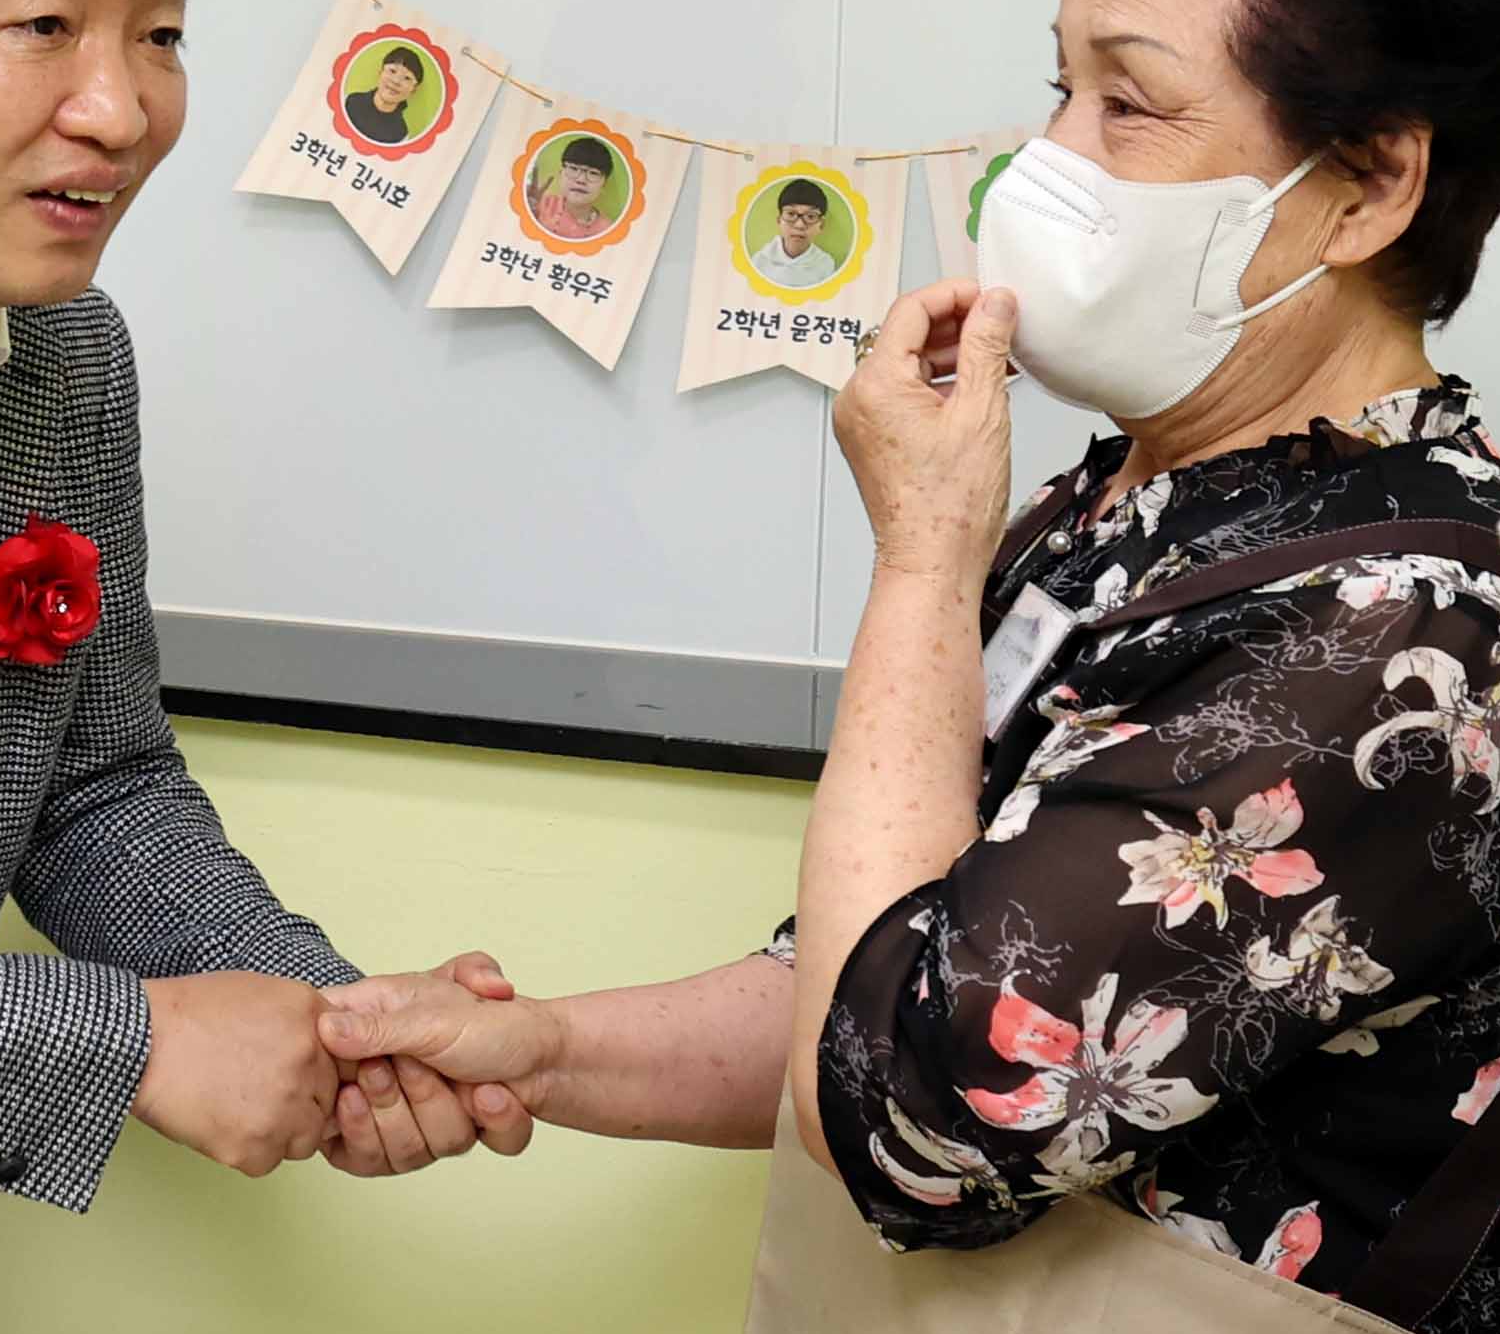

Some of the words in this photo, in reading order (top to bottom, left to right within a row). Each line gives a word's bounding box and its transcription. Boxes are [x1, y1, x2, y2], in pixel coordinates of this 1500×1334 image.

[290, 132, 348, 178] 3학년
[349, 162, 411, 209] 김시호
[481, 242, 544, 281] 3학년
[547, 263, 614, 304] 황우주
[717, 309, 781, 339] 2학년
[790, 314, 861, 347] 윤정혁
